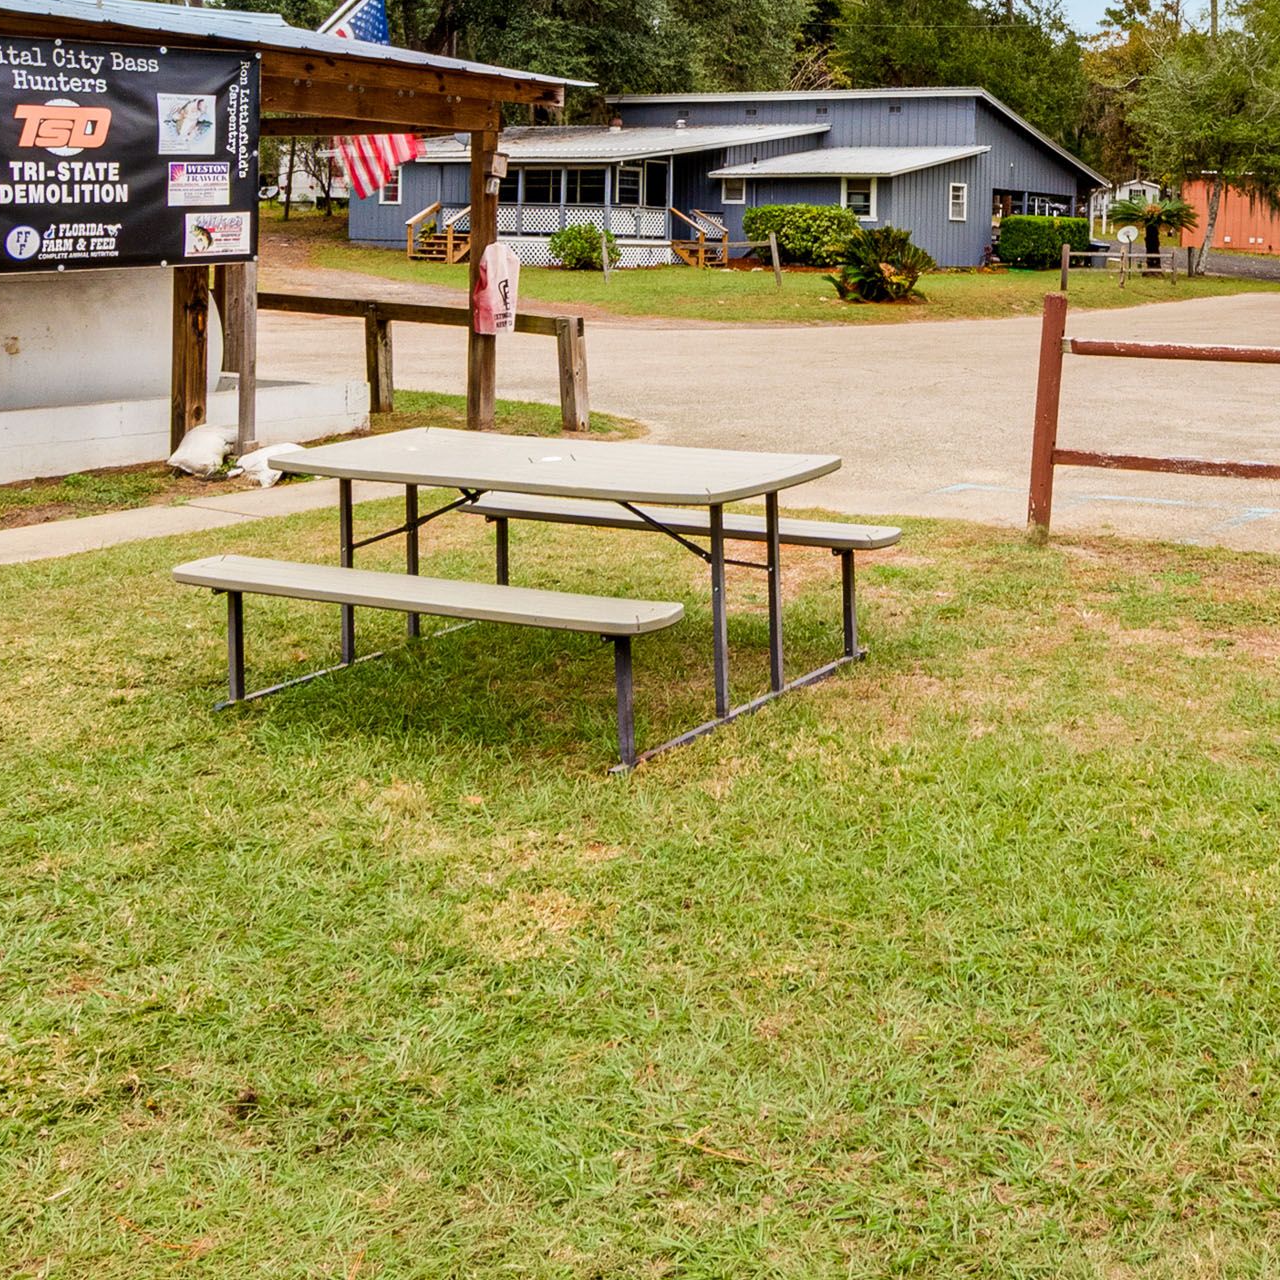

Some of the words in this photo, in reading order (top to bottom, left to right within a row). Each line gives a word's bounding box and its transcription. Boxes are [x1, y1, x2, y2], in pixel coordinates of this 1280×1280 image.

[52, 43, 105, 74] City
[110, 52, 160, 73] Bass
[12, 70, 108, 93] Hunters
[240, 61, 251, 85] Ron
[14, 104, 113, 149] TSD
[226, 84, 239, 154] Carpentry
[238, 89, 250, 178] Littlefield's
[9, 161, 120, 181] TRI-STATE
[187, 165, 227, 173] WESTON
[58, 223, 105, 237] FLORIDA
[38, 251, 68, 260] COMPLETE
[42, 238, 73, 252] FARM
[76, 238, 87, 251] &
[90, 237, 116, 251] FEED
